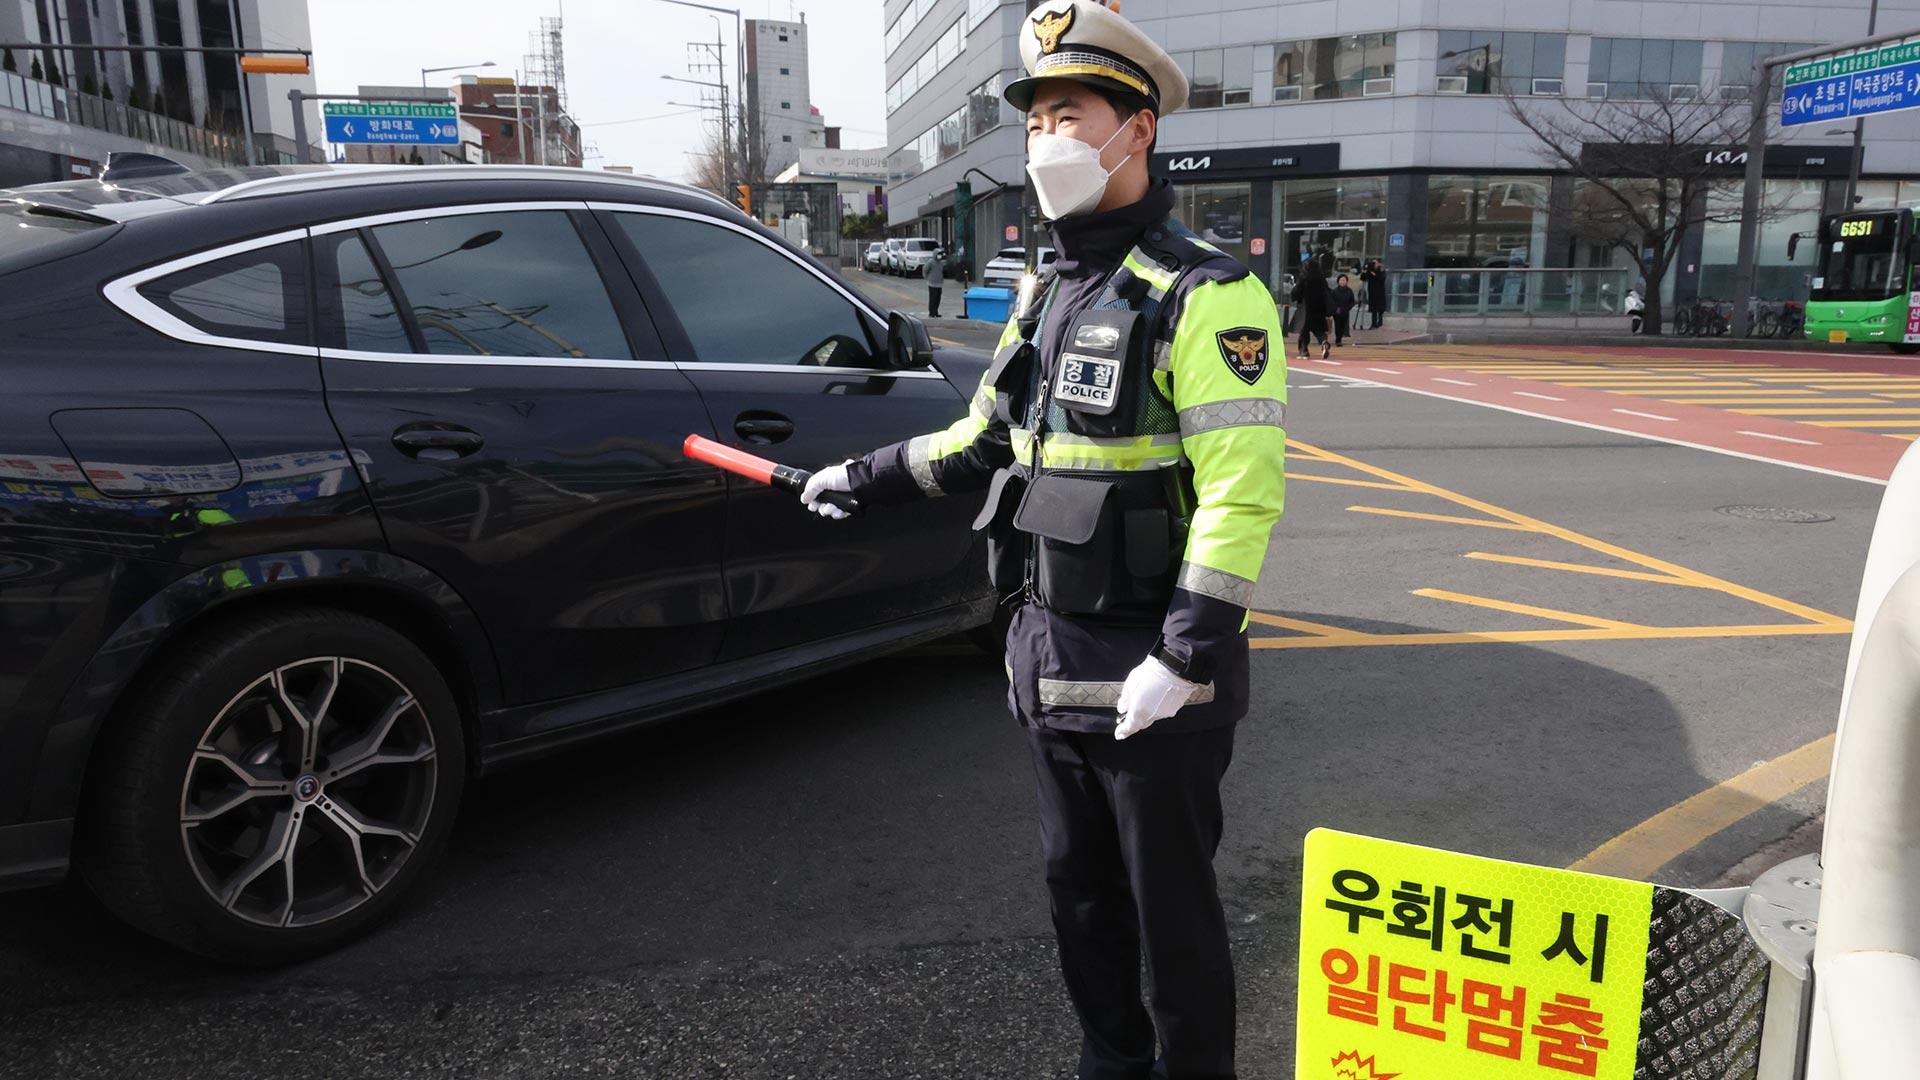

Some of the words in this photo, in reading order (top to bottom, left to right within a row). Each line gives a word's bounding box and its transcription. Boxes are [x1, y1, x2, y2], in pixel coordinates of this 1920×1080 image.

[1815, 81, 1846, 101] 초원로
[369, 120, 414, 132] 방화대로
[1169, 156, 1210, 171] KIA
[1062, 385, 1108, 400] POLICE
[1325, 869, 1514, 965] 우회전
[1541, 911, 1609, 983] 시
[1320, 947, 1609, 1077] 일단멈춤
